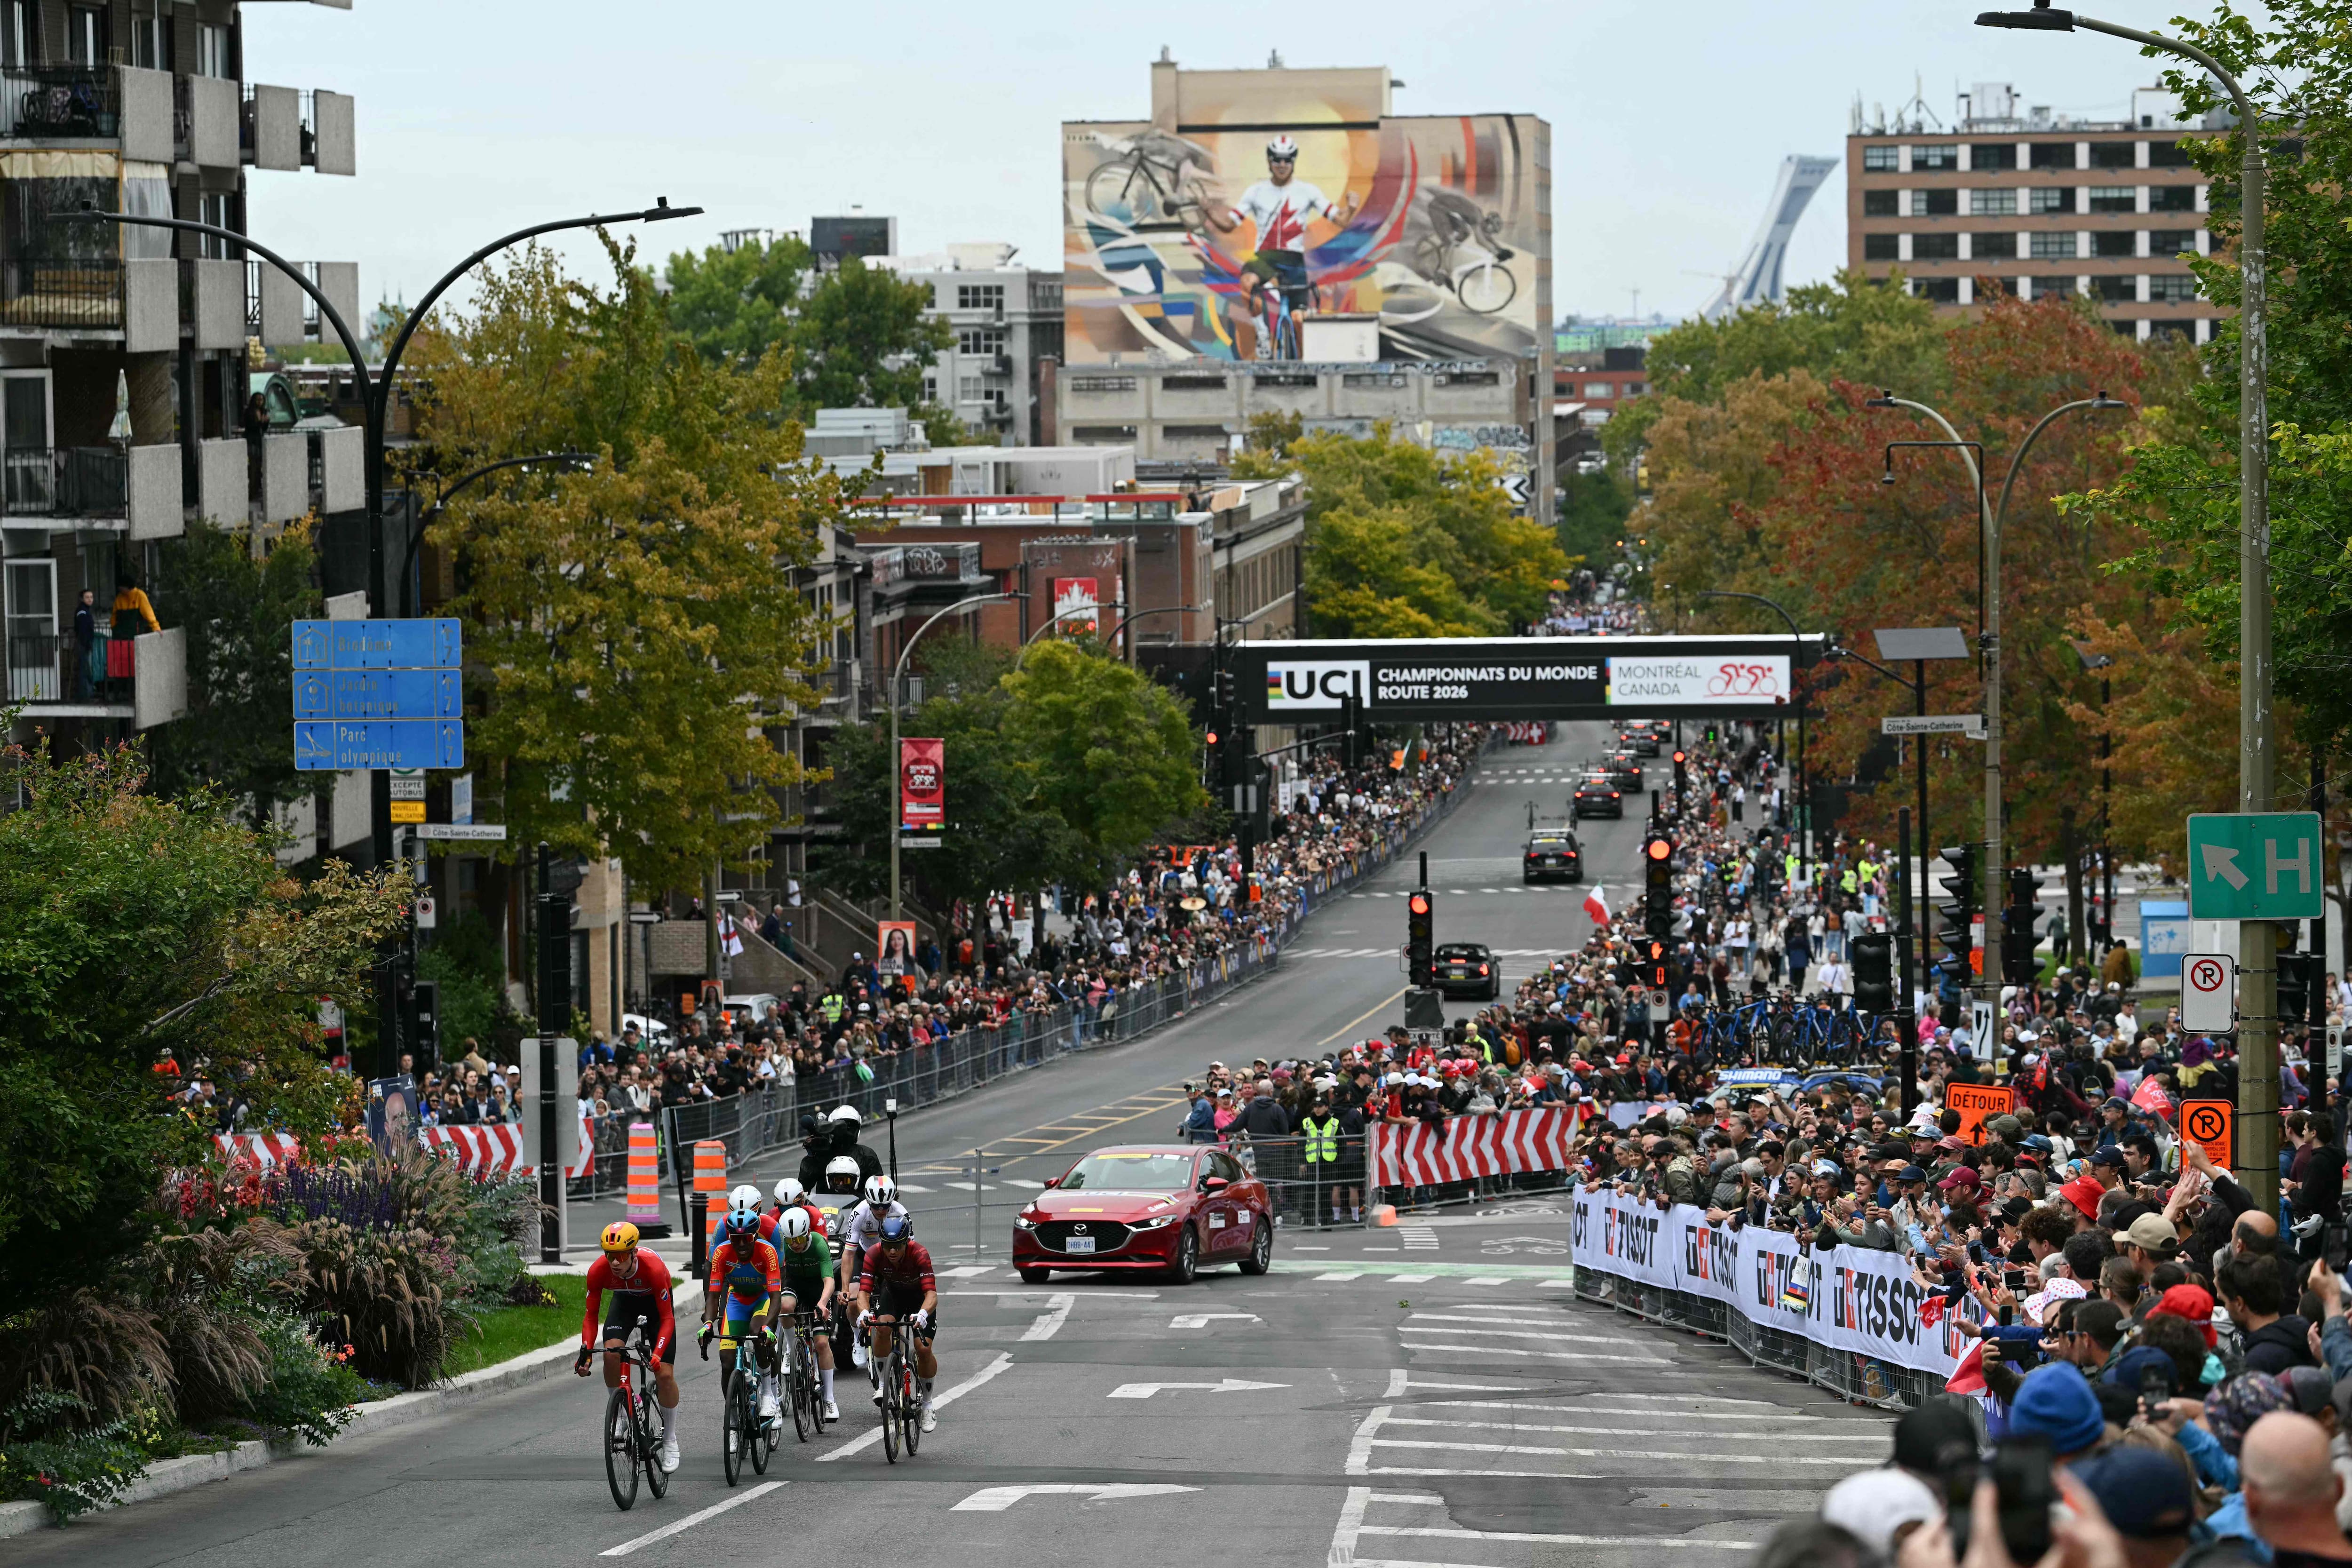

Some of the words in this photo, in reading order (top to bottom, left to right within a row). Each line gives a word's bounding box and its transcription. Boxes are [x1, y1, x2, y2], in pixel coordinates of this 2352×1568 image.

[1378, 668, 1505, 682] CHAMPIONNATS
[1509, 667, 1532, 681] DU
[1535, 666, 1598, 680] MONDE
[1619, 662, 1701, 678] MONTRÉAL
[340, 676, 377, 691] Jardin
[1287, 670, 1361, 699] UCI
[1378, 685, 1430, 700] ROUTE
[1433, 685, 1468, 699] 2026
[1619, 683, 1681, 696] CANADA
[340, 697, 398, 715] botanique
[341, 727, 366, 742] Parc
[342, 748, 402, 766] olympique
[2265, 838, 2311, 894] H
[1718, 1071, 1782, 1081] SHIMANO
[1953, 1091, 2006, 1111] DÉTOUR
[1618, 1210, 1659, 1267] TISSOT
[712, 1249, 723, 1272] ERITREA
[764, 1247, 777, 1272] ERITREA
[1709, 1231, 1739, 1295] TISSOT
